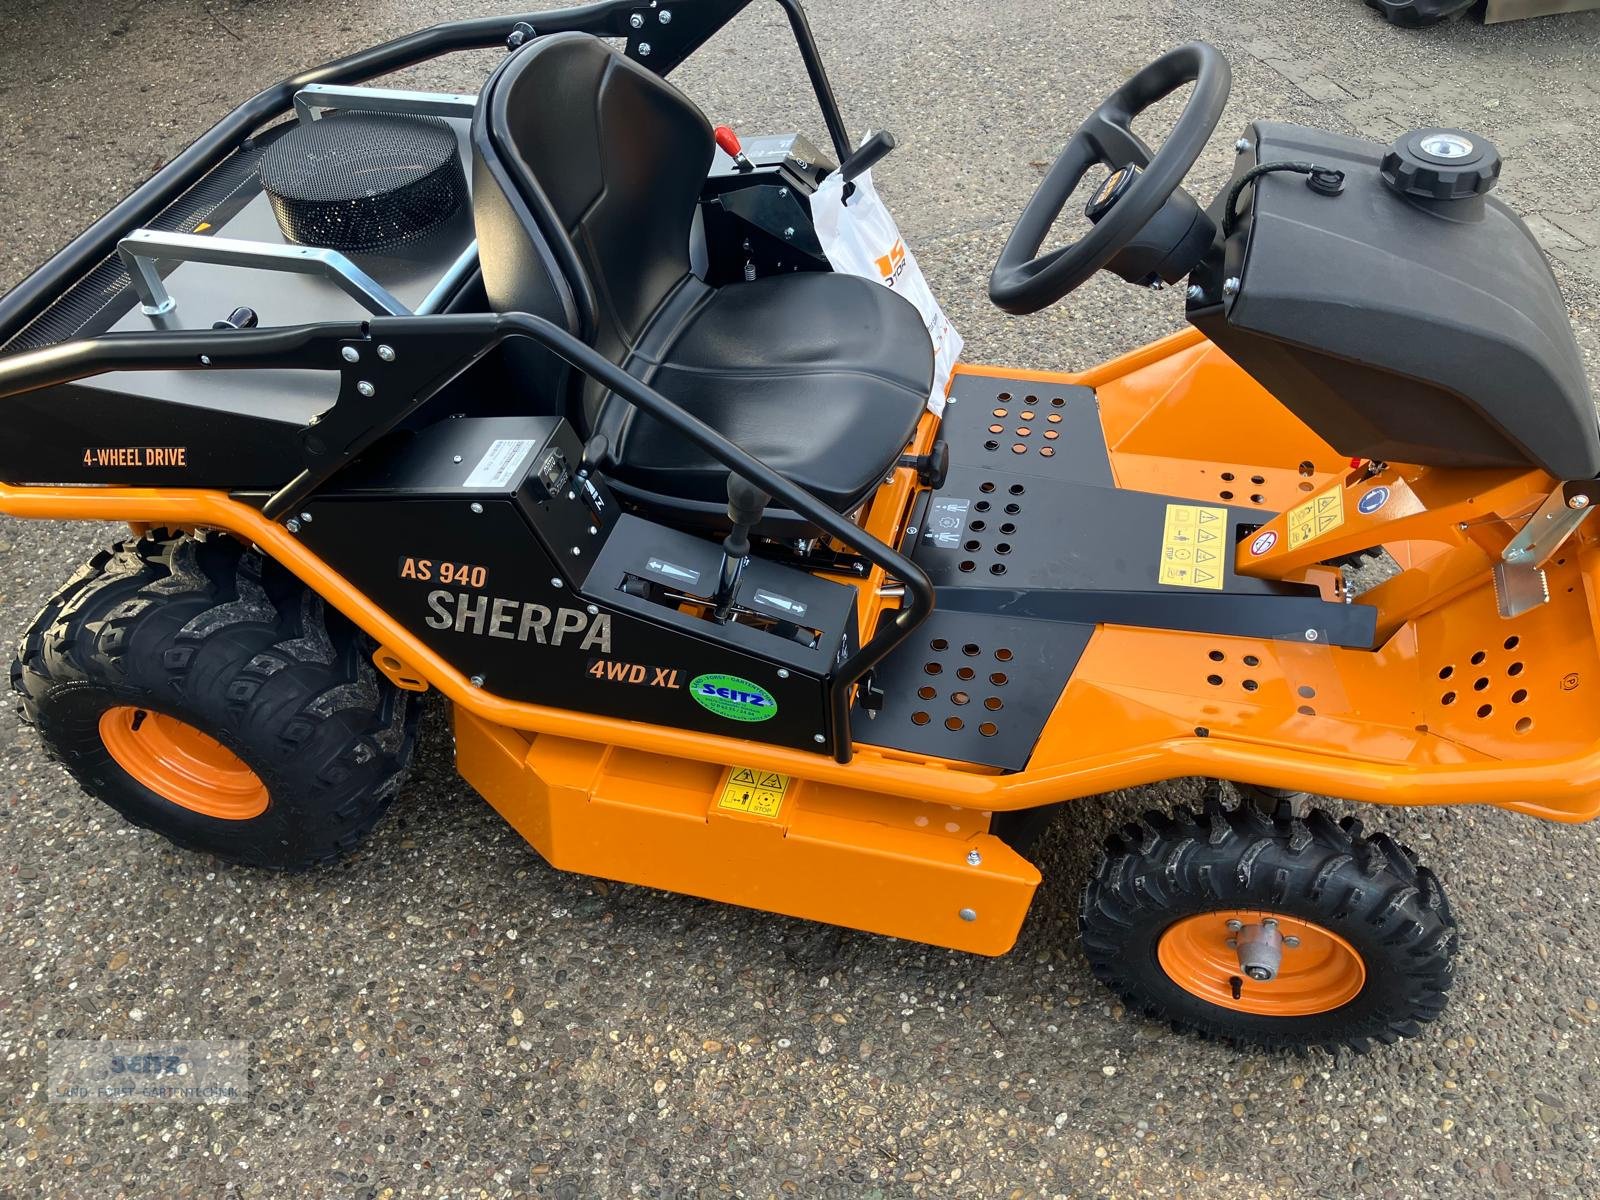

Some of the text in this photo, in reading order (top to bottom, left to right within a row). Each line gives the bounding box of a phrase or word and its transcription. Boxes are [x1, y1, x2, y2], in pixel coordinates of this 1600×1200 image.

[83, 448, 186, 466] 4-WHEEL DRIVE
[401, 558, 487, 588] AS 940
[425, 590, 612, 654] SHERPA
[589, 660, 682, 689] 4WD XL
[702, 683, 765, 707] SEITZ
